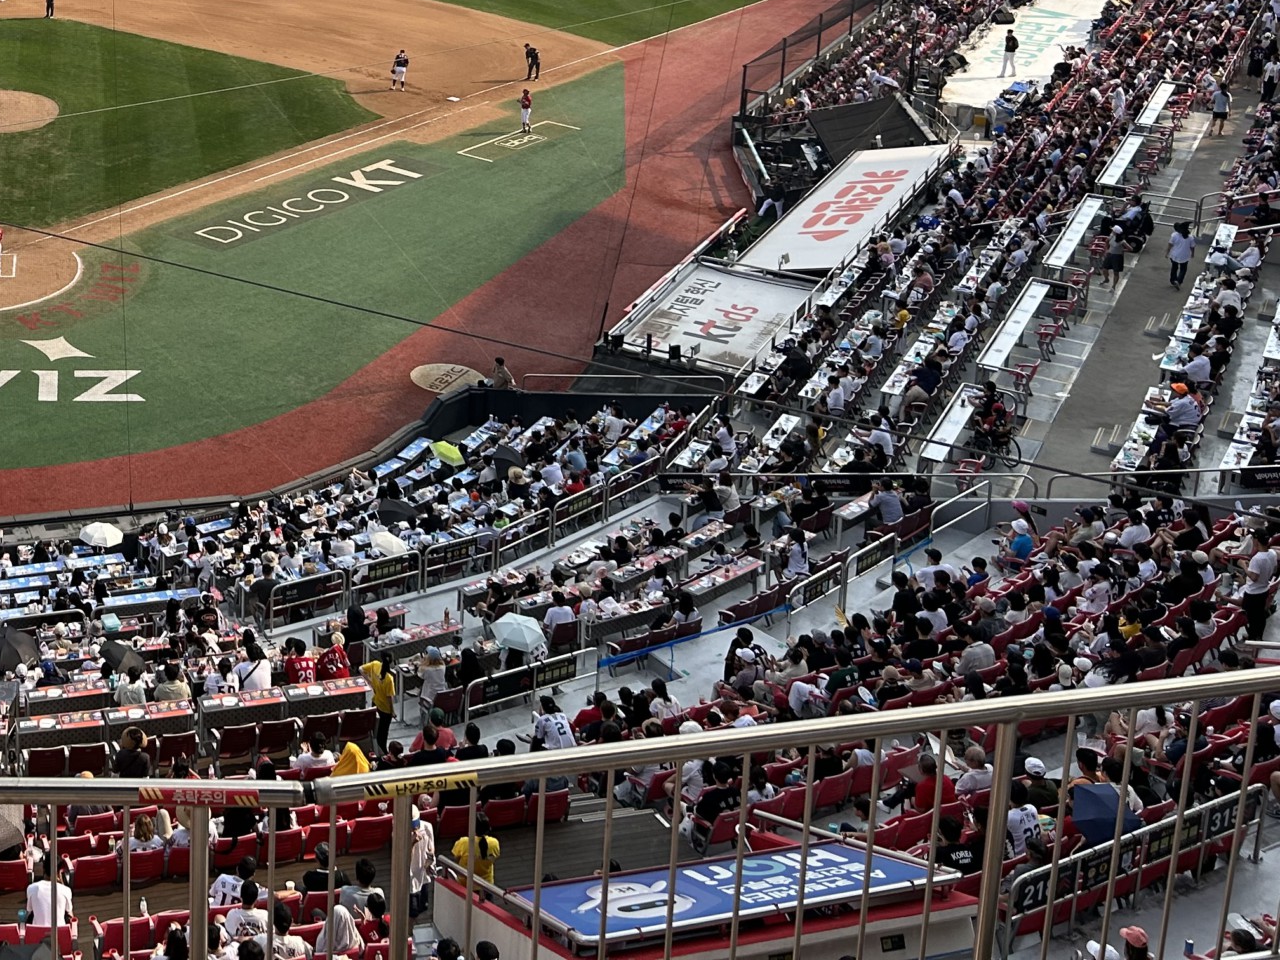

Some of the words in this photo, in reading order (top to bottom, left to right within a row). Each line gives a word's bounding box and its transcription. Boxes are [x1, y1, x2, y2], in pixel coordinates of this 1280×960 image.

[194, 188, 350, 244] DIGICO
[331, 158, 424, 193] KT
[16, 302, 86, 331] KT
[683, 314, 737, 345] kt
[721, 304, 760, 331] ds
[172, 789, 227, 804] 추락주의
[950, 850, 974, 861] KOREA
